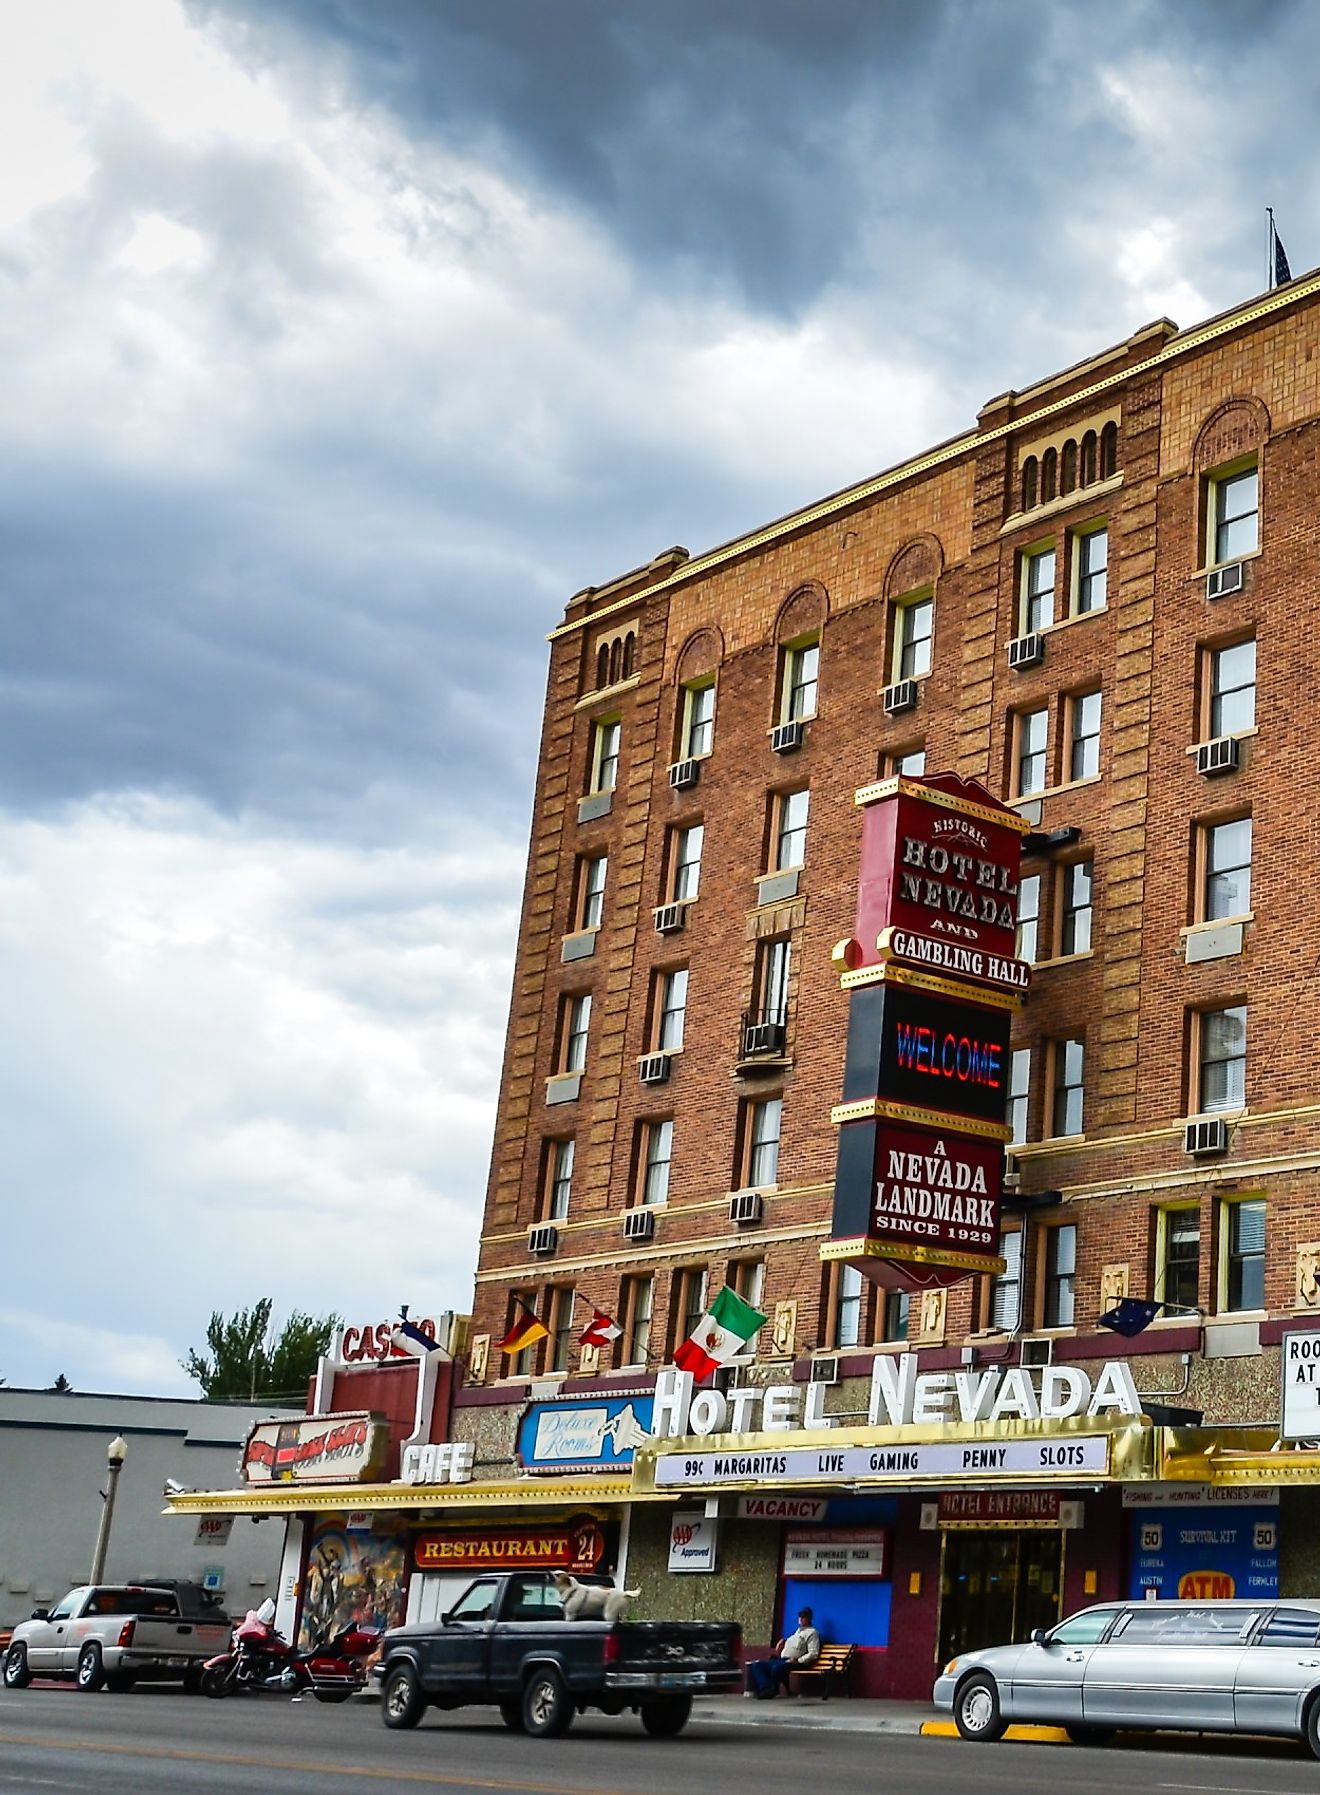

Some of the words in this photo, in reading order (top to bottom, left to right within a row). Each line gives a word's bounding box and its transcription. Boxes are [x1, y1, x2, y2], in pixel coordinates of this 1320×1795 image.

[933, 818, 988, 848] HISTORIC
[903, 837, 1018, 895] HOTEL
[901, 872, 1015, 930] NEVADA
[930, 919, 979, 940] AND
[893, 932, 983, 975] GAMBLING
[988, 957, 1029, 987] HALL
[896, 1021, 1002, 1088] WELCOME
[934, 1140, 946, 1156] A
[887, 1150, 987, 1194] NEVADA
[875, 1182, 995, 1228] LANDMARK
[876, 1216, 940, 1235] SINCE
[948, 1228, 992, 1244] 1929
[342, 1319, 436, 1362] CASO
[1296, 1363, 1315, 1383] AT
[651, 1370, 839, 1437] HOTEL
[868, 1353, 1143, 1426] NEVADA
[403, 1443, 475, 1485] CAFE
[714, 1456, 787, 1476] MARGARITAS
[818, 1455, 844, 1472] LIVE
[869, 1452, 918, 1471] GAMING
[963, 1448, 1007, 1468] PENNY
[1040, 1446, 1084, 1466] SLOTS
[944, 1494, 980, 1514] HOTEL
[988, 1493, 1056, 1514] ENTRANCE
[1207, 1486, 1250, 1499] LICENSES
[745, 1499, 821, 1517] VACANCY
[1144, 1531, 1159, 1545] 50
[1180, 1530, 1218, 1543] SURVIVAL
[1220, 1530, 1237, 1543] KIT
[1256, 1530, 1272, 1545] 50
[424, 1539, 568, 1559] RESTAURANT
[578, 1535, 594, 1561] 24
[681, 1547, 710, 1558] Approved
[852, 1549, 869, 1559] PIZZA
[1251, 1558, 1277, 1567] FALLON
[1140, 1576, 1163, 1585] AUSTIN
[1181, 1576, 1231, 1599] ATM
